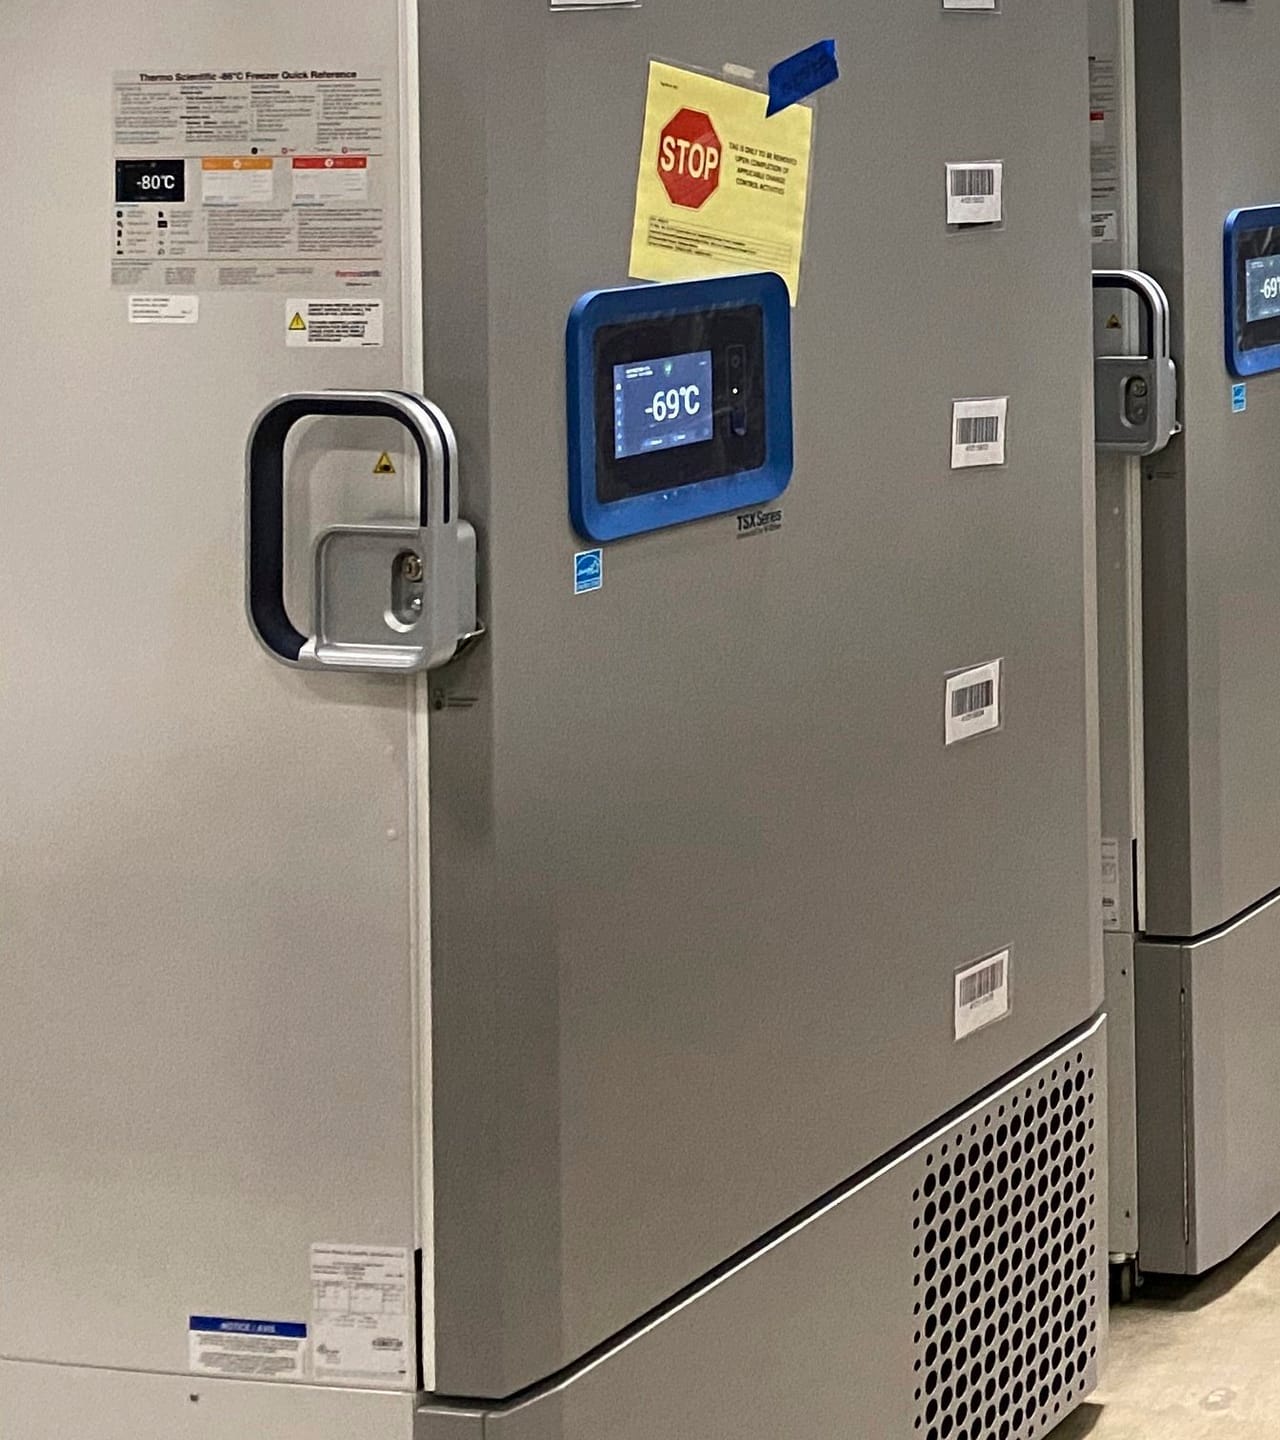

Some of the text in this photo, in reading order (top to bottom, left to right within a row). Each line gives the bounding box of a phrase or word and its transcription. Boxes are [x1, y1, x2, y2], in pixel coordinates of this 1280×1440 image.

[140, 73, 173, 81] Thermo
[245, 71, 279, 80] Freezer
[281, 71, 308, 79] Quick
[310, 70, 357, 79] Reference
[660, 136, 719, 180] STOP
[136, 174, 176, 190] -80°C
[644, 384, 700, 422] -69°C
[737, 512, 756, 531] TSX
